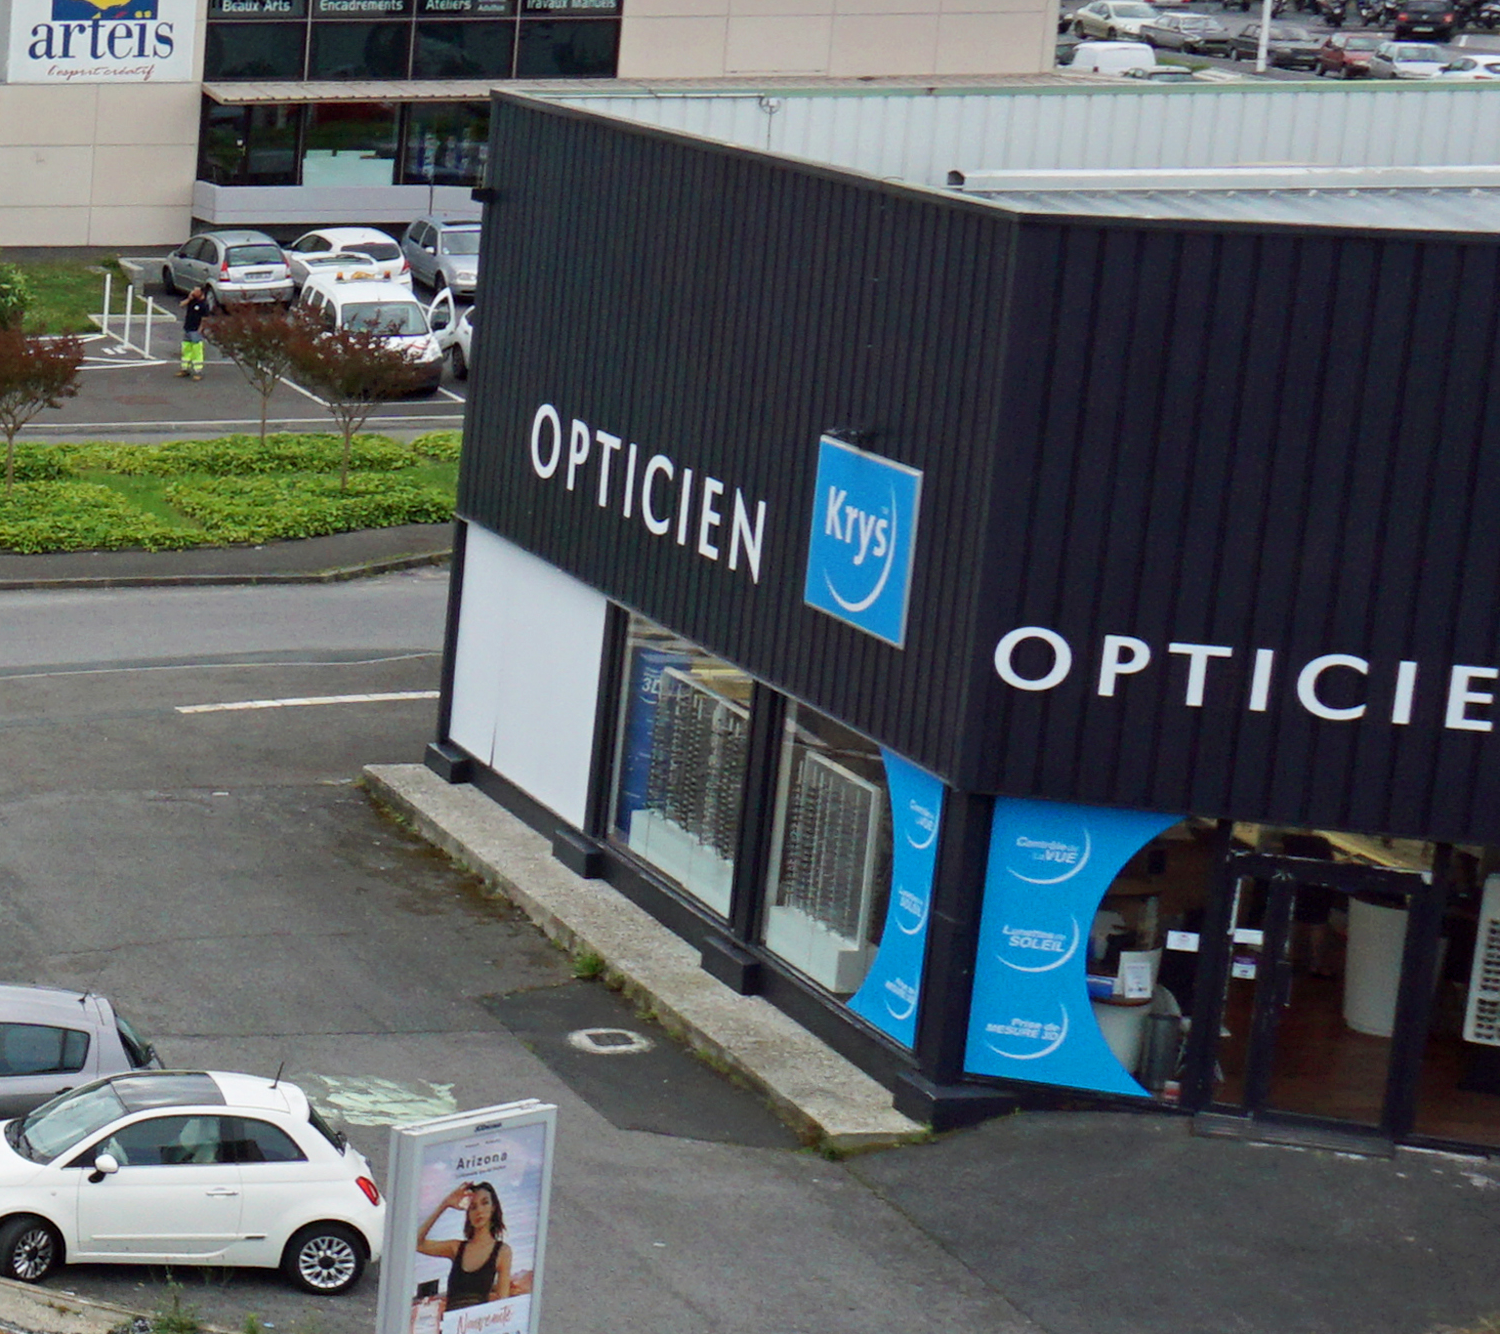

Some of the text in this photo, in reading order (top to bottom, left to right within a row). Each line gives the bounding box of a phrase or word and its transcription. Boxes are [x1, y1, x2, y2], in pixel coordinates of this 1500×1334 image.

[103, 64, 155, 80] créatif
[530, 403, 767, 585] OPTICIEN
[824, 485, 891, 566] Krys
[993, 625, 1500, 732] OPTICIE
[1044, 849, 1078, 864] VUE
[1008, 935, 1065, 952] SOLEIL
[984, 1023, 1039, 1039] MESURE
[456, 1149, 509, 1171] Arizona
